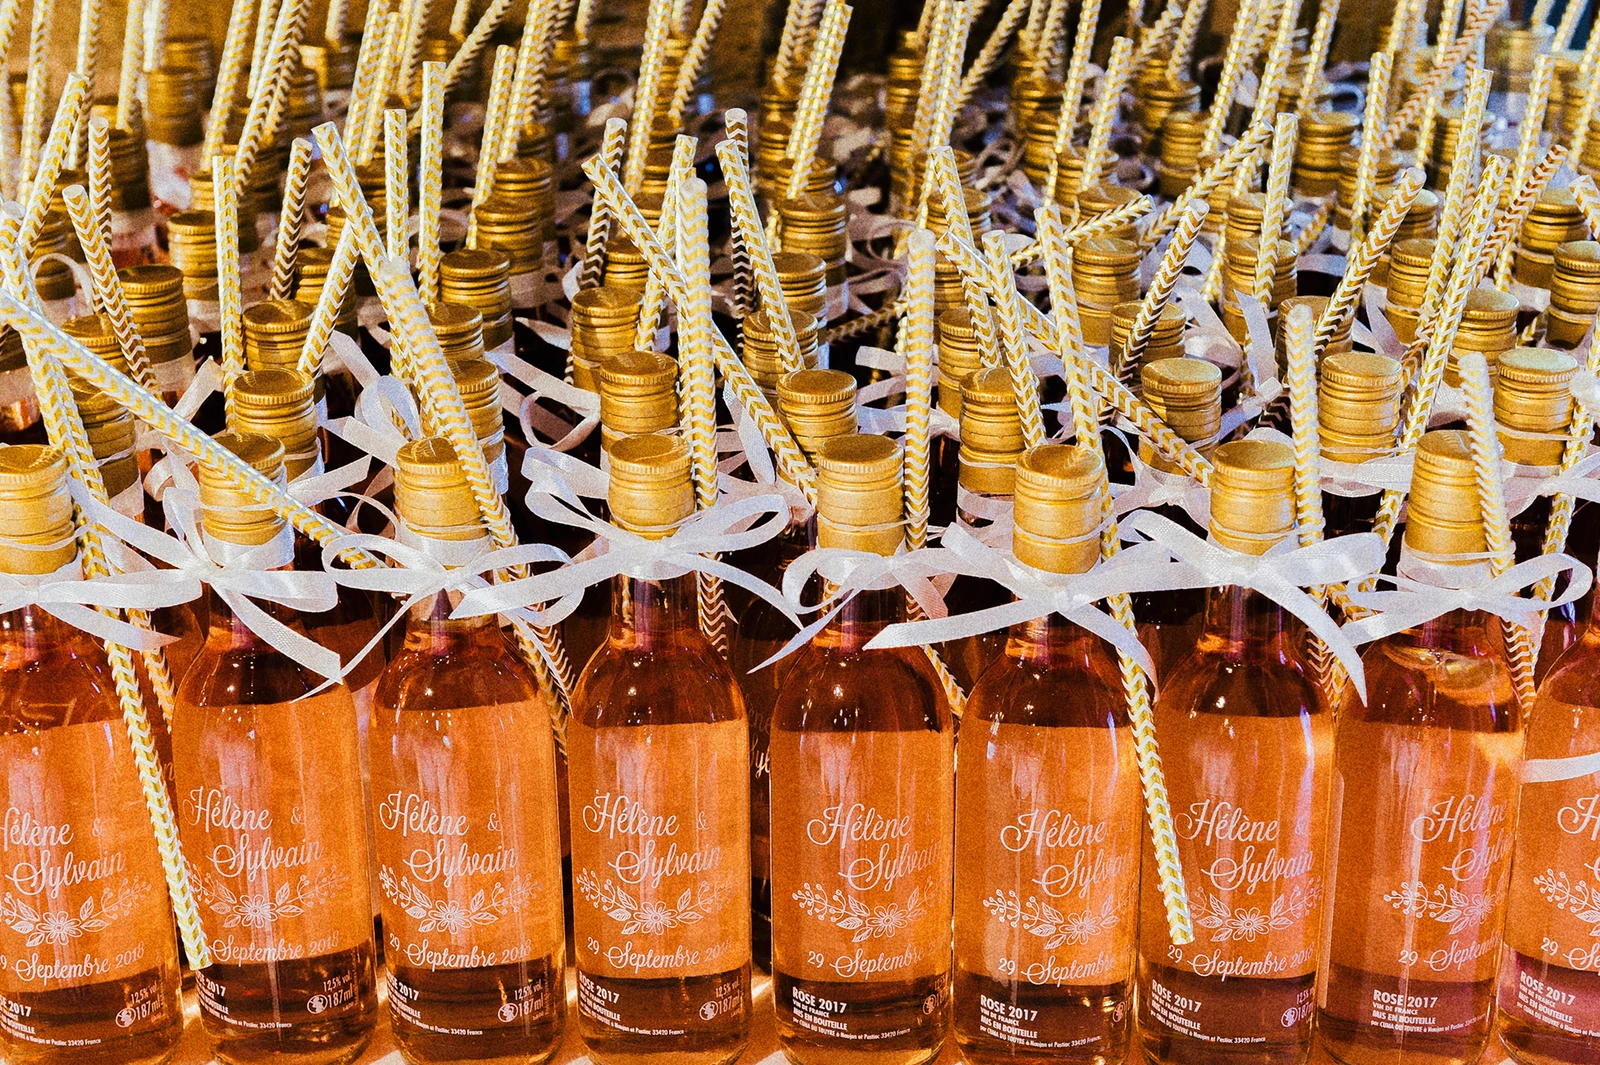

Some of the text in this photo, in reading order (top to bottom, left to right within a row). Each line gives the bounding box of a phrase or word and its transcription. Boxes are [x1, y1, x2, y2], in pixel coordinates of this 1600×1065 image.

[183, 785, 305, 833] Hélène &
[379, 790, 501, 837] Hélène &
[583, 792, 709, 839] Hélène &
[1174, 798, 1280, 846] Hélène
[806, 802, 912, 849] Hélène
[1000, 808, 1107, 856] Hélène
[206, 833, 323, 882] Sylvain
[402, 838, 519, 888] Sylvain
[608, 839, 721, 889] Sylvain
[1201, 845, 1314, 895] Sylvain
[4, 850, 126, 899] Sylvain
[209, 930, 340, 967] Septembre 2018
[389, 933, 532, 972] 29 Septembre 2018
[587, 936, 600, 955] 29
[603, 941, 700, 974] Septembre
[807, 951, 824, 969] 29
[829, 943, 925, 980] Septembre
[1398, 950, 1418, 966] 29
[1540, 937, 1559, 956] 29
[0, 941, 145, 986] 9 Septembre 2018
[998, 958, 1015, 975] 29
[1167, 944, 1183, 963] 29
[1187, 948, 1287, 982] Septembre
[206, 978, 226, 997] 2017
[399, 982, 419, 1001] 2017
[596, 985, 620, 1004] 2017
[792, 986, 847, 1014] ROSE 2017
[1152, 979, 1202, 1013] ROSE 2017
[1373, 989, 1438, 1009] ROSE 2017
[1520, 970, 1576, 1006] ROSE 2017
[8, 1000, 31, 1017] 2017
[809, 1007, 830, 1018] FRANCE
[813, 1016, 847, 1031] BOUTEILLE
[980, 994, 1038, 1022] ROSE 2017
[998, 1014, 1019, 1026] FRANCE
[1169, 1012, 1201, 1031] BOUTEILLE
[1372, 1010, 1436, 1025] MIS EN BOUTEILLE
[1373, 1002, 1384, 1010] VIN
[1394, 1007, 1418, 1015] FRANCE
[1538, 1003, 1573, 1024] BOUTEILLE
[993, 1020, 1001, 1030] EN
[1002, 1024, 1038, 1039] BOUTEILLE
[1071, 1039, 1087, 1047] 33420
